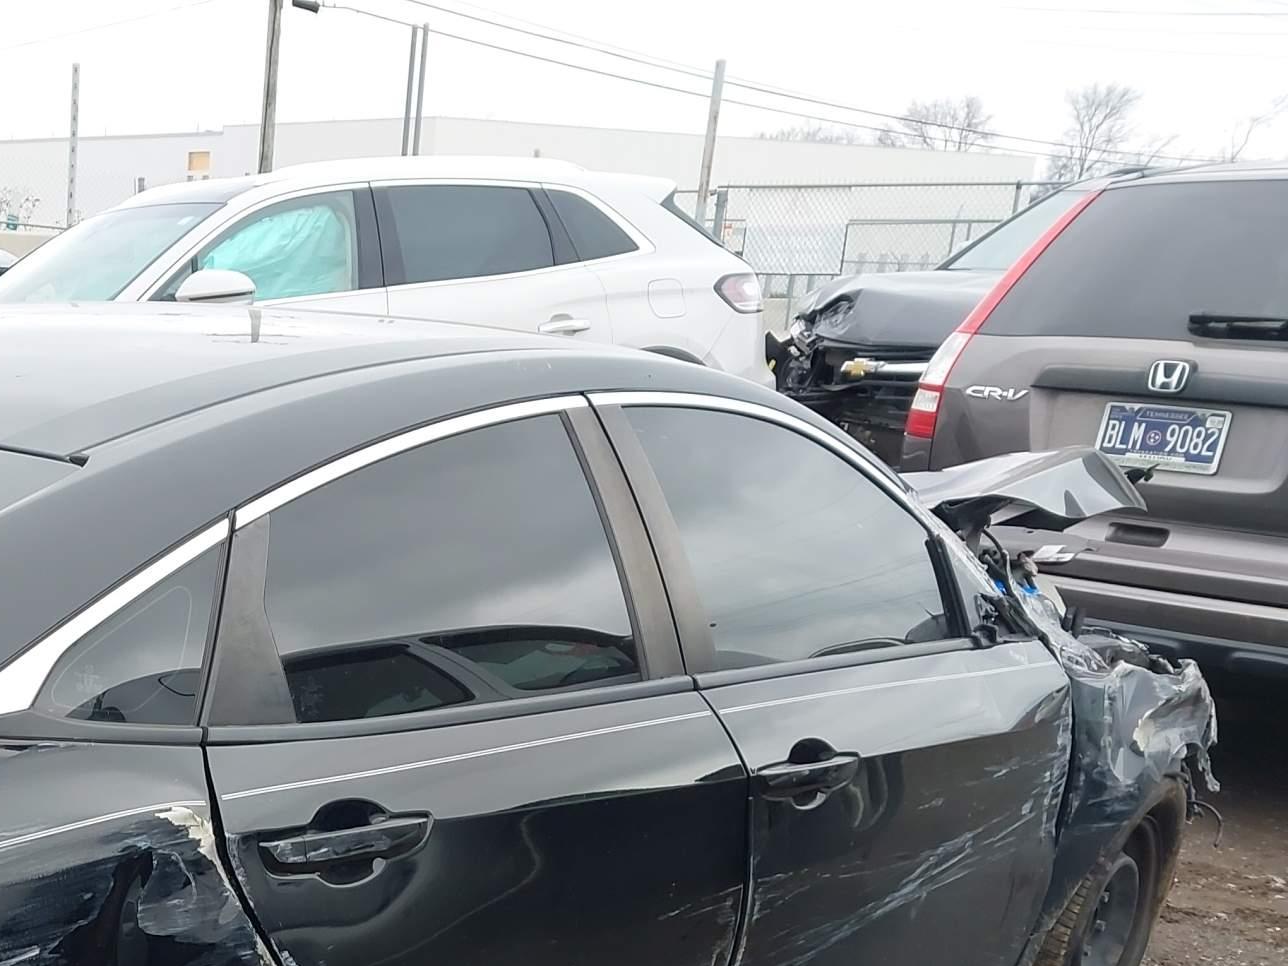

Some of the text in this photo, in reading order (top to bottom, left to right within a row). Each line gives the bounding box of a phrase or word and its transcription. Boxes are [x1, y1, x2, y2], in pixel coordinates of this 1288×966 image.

[965, 385, 1029, 401] CR-V
[1102, 420, 1220, 457] BLM 9082
